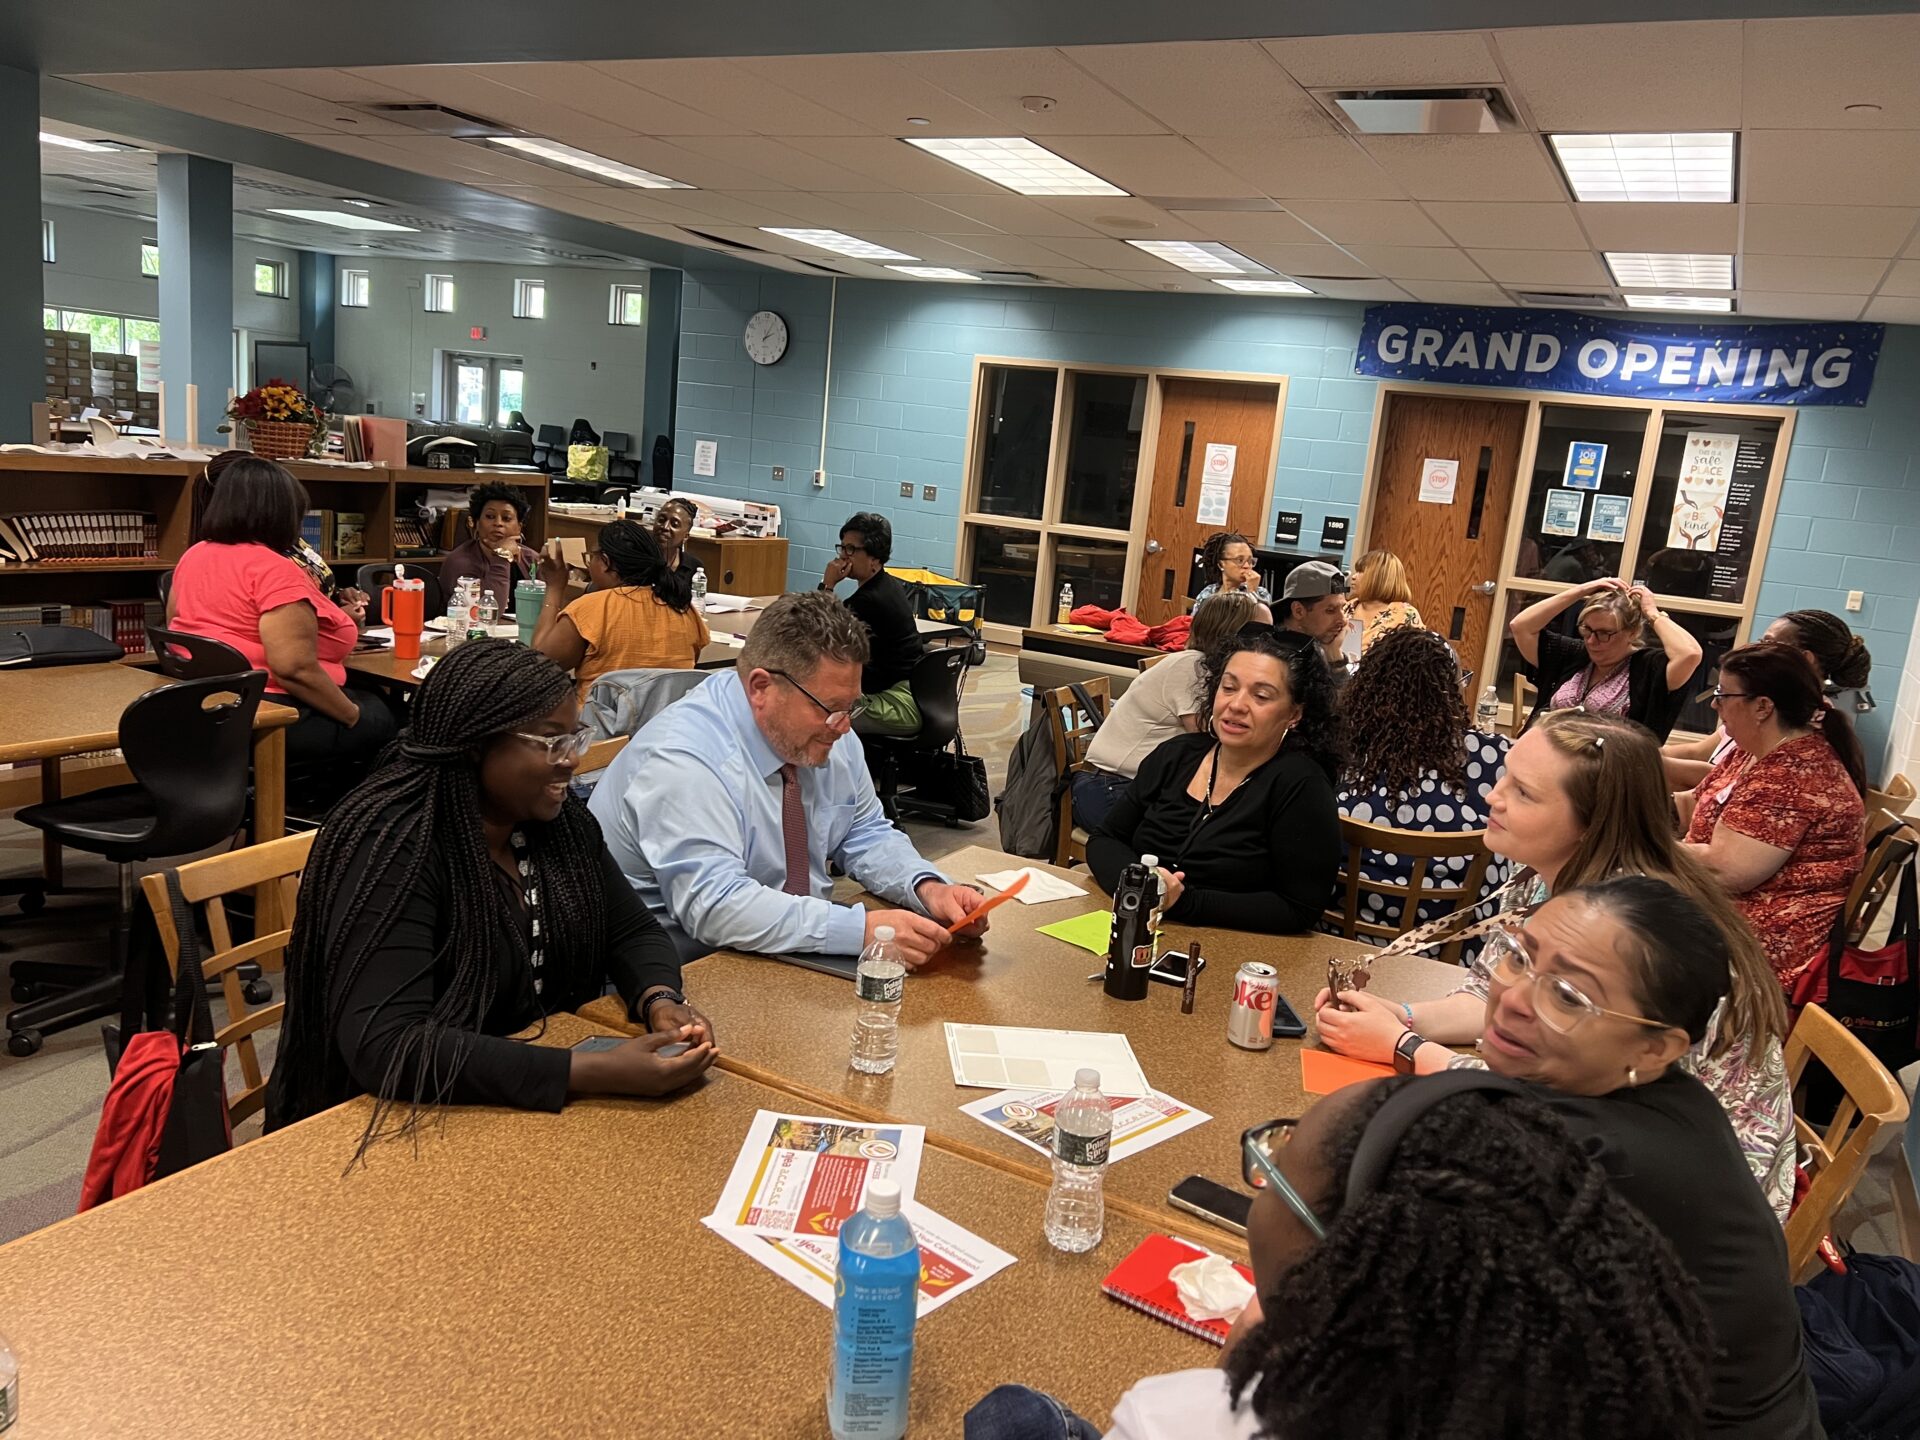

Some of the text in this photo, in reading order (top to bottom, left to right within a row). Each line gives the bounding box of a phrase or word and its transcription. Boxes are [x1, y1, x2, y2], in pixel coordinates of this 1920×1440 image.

[1377, 324, 1853, 389] GRAND OPENING
[1579, 450, 1597, 460] JOB
[1690, 465, 1724, 475] PLACE
[1432, 475, 1447, 483] STOP
[781, 1152, 799, 1168] njea
